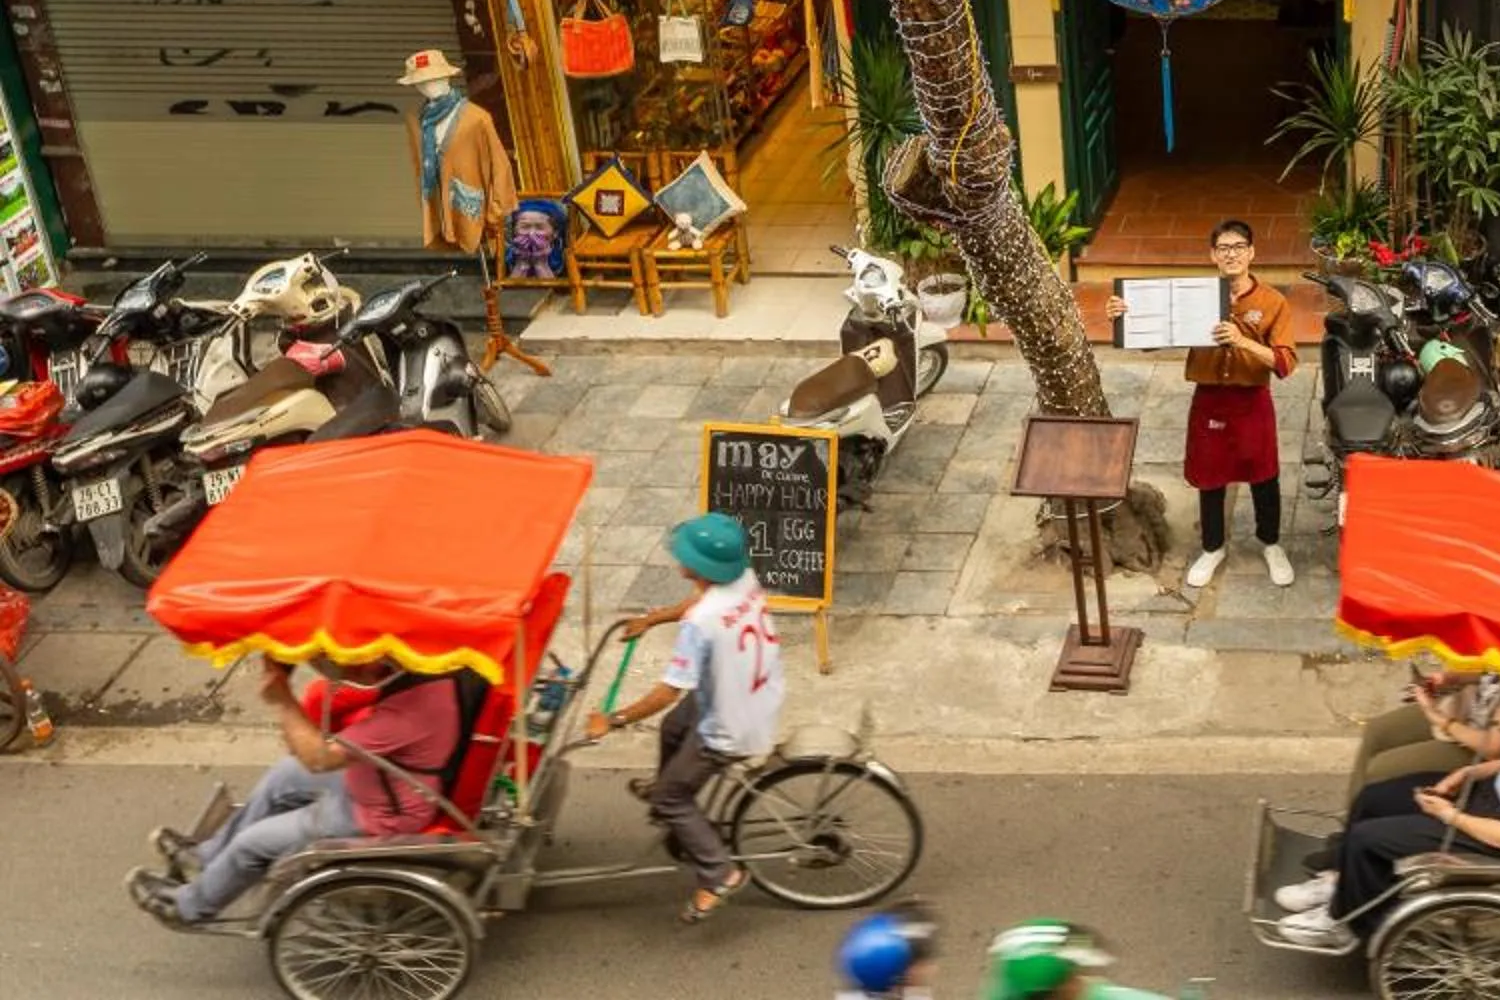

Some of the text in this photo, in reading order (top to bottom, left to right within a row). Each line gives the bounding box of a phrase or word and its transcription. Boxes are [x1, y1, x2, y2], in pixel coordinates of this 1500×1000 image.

[717, 440, 807, 469] may
[714, 480, 828, 511] HAPPY HOUR
[783, 516, 816, 542] EGG
